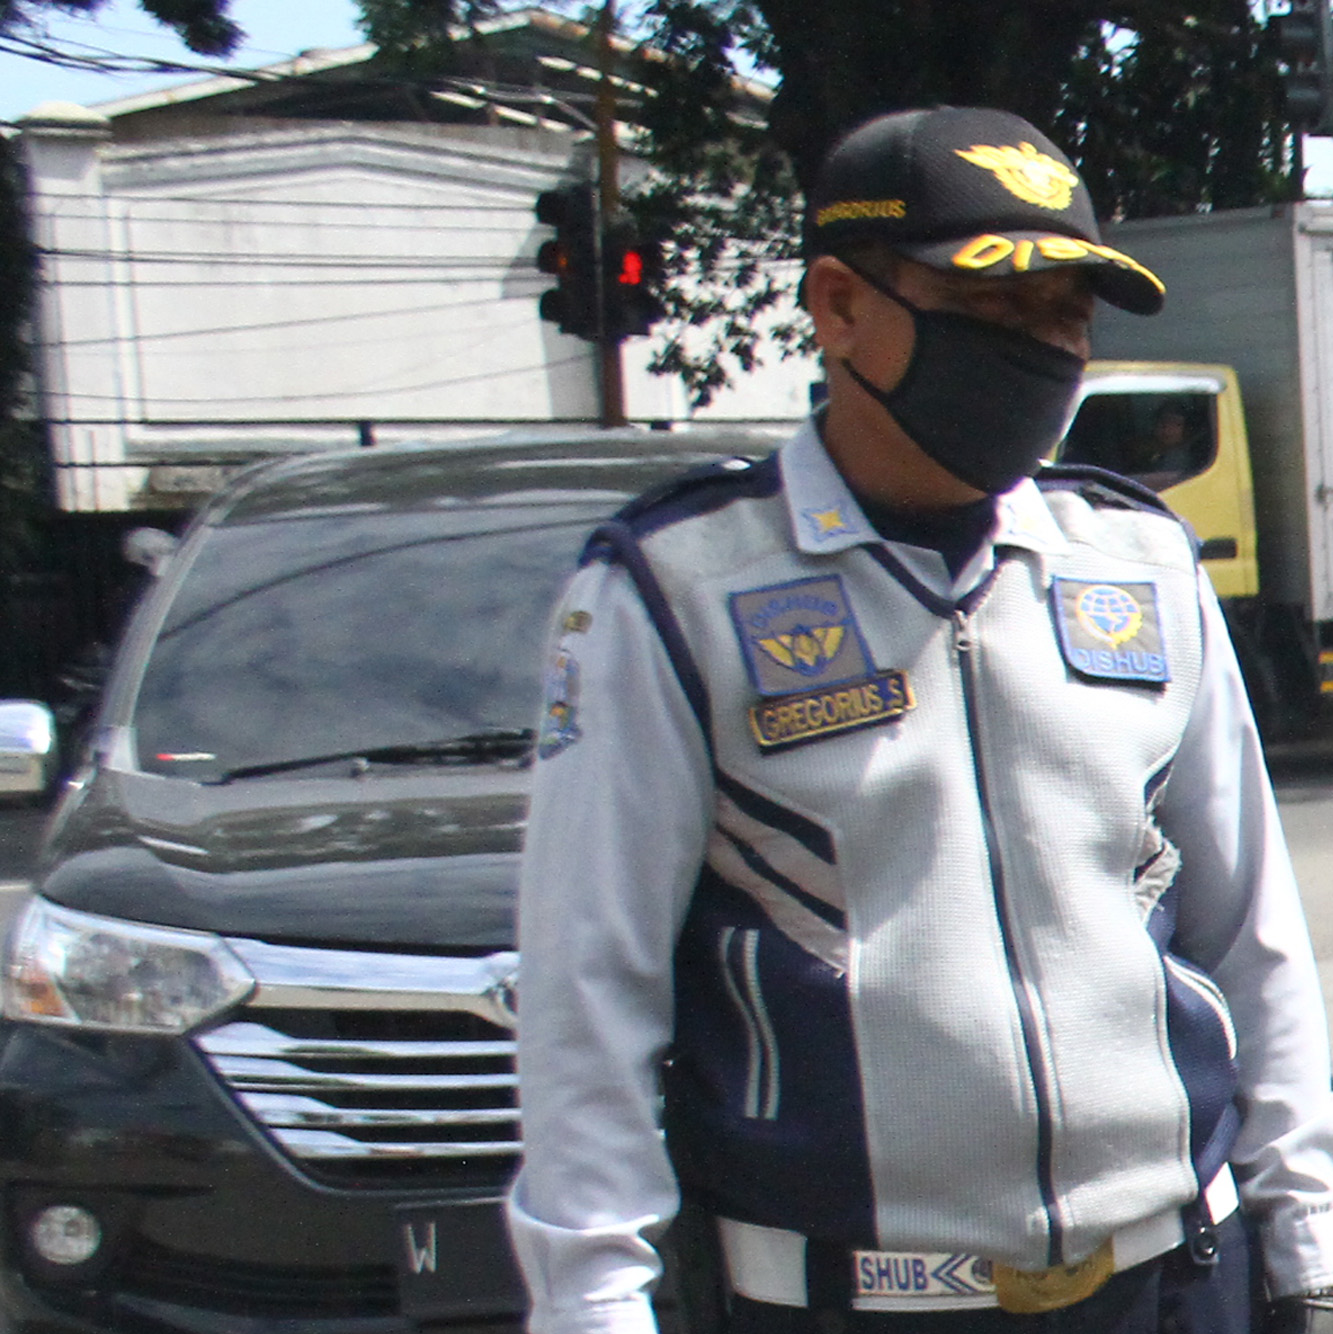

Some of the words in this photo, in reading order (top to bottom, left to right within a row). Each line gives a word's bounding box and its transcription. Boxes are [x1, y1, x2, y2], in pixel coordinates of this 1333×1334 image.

[1071, 648, 1166, 674] DISHUB
[763, 683, 883, 739] GREGORIUS
[404, 1222, 436, 1274] W
